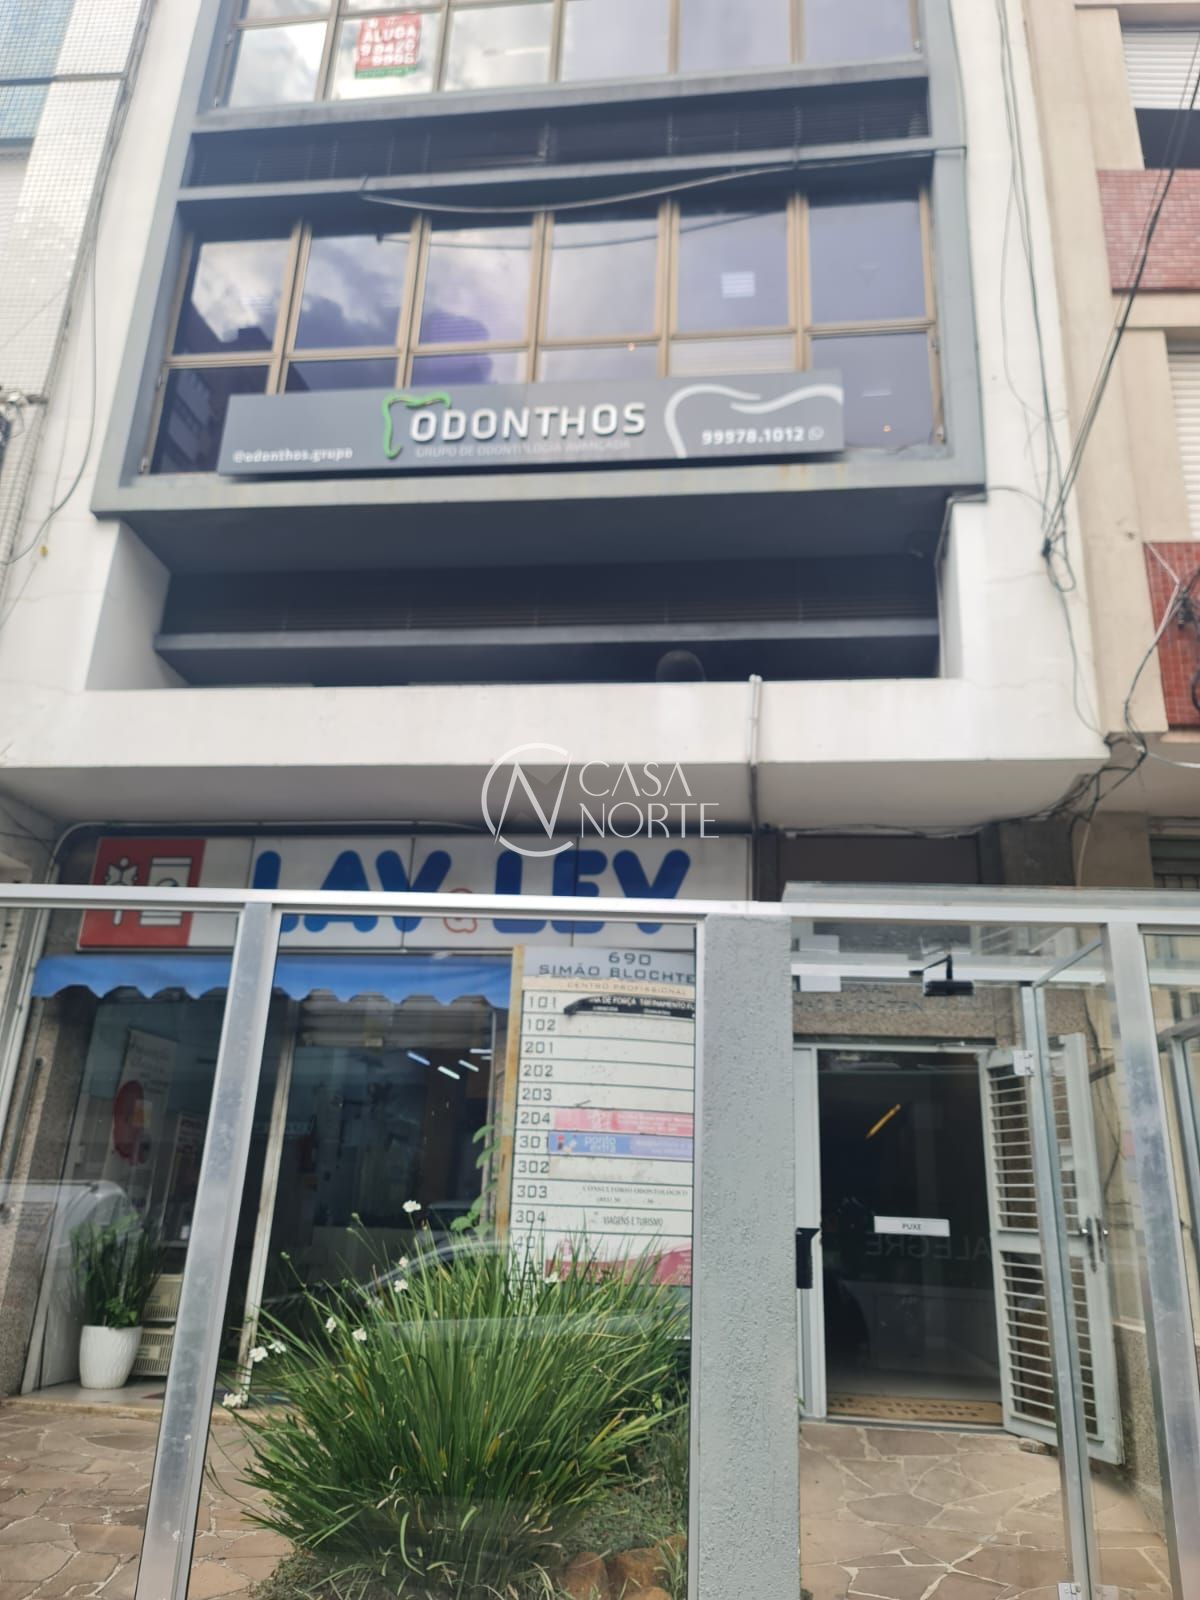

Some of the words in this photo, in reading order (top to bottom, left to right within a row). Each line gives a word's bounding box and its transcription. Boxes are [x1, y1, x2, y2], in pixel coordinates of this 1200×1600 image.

[362, 24, 417, 43] ALUGA
[410, 402, 647, 442] ODONTHOS
[702, 426, 804, 445] 99978.1012
[233, 446, 353, 464] @odonthos.grupo
[416, 446, 456, 458] GRUPO
[461, 446, 473, 457] DE
[253, 849, 452, 933] LAV
[492, 848, 691, 935] LEV
[608, 951, 652, 966] 690
[539, 962, 600, 976] SIMÃO
[567, 981, 610, 990] CENTRO
[529, 996, 557, 1009] 101
[528, 1019, 555, 1031] 102
[525, 1041, 553, 1054] 201
[523, 1064, 553, 1077] 202
[522, 1087, 552, 1101] 203
[520, 1111, 550, 1124] 204
[518, 1160, 549, 1173] 302
[517, 1185, 547, 1198] 303
[515, 1210, 546, 1223] 304
[902, 1222, 922, 1231] PUXE
